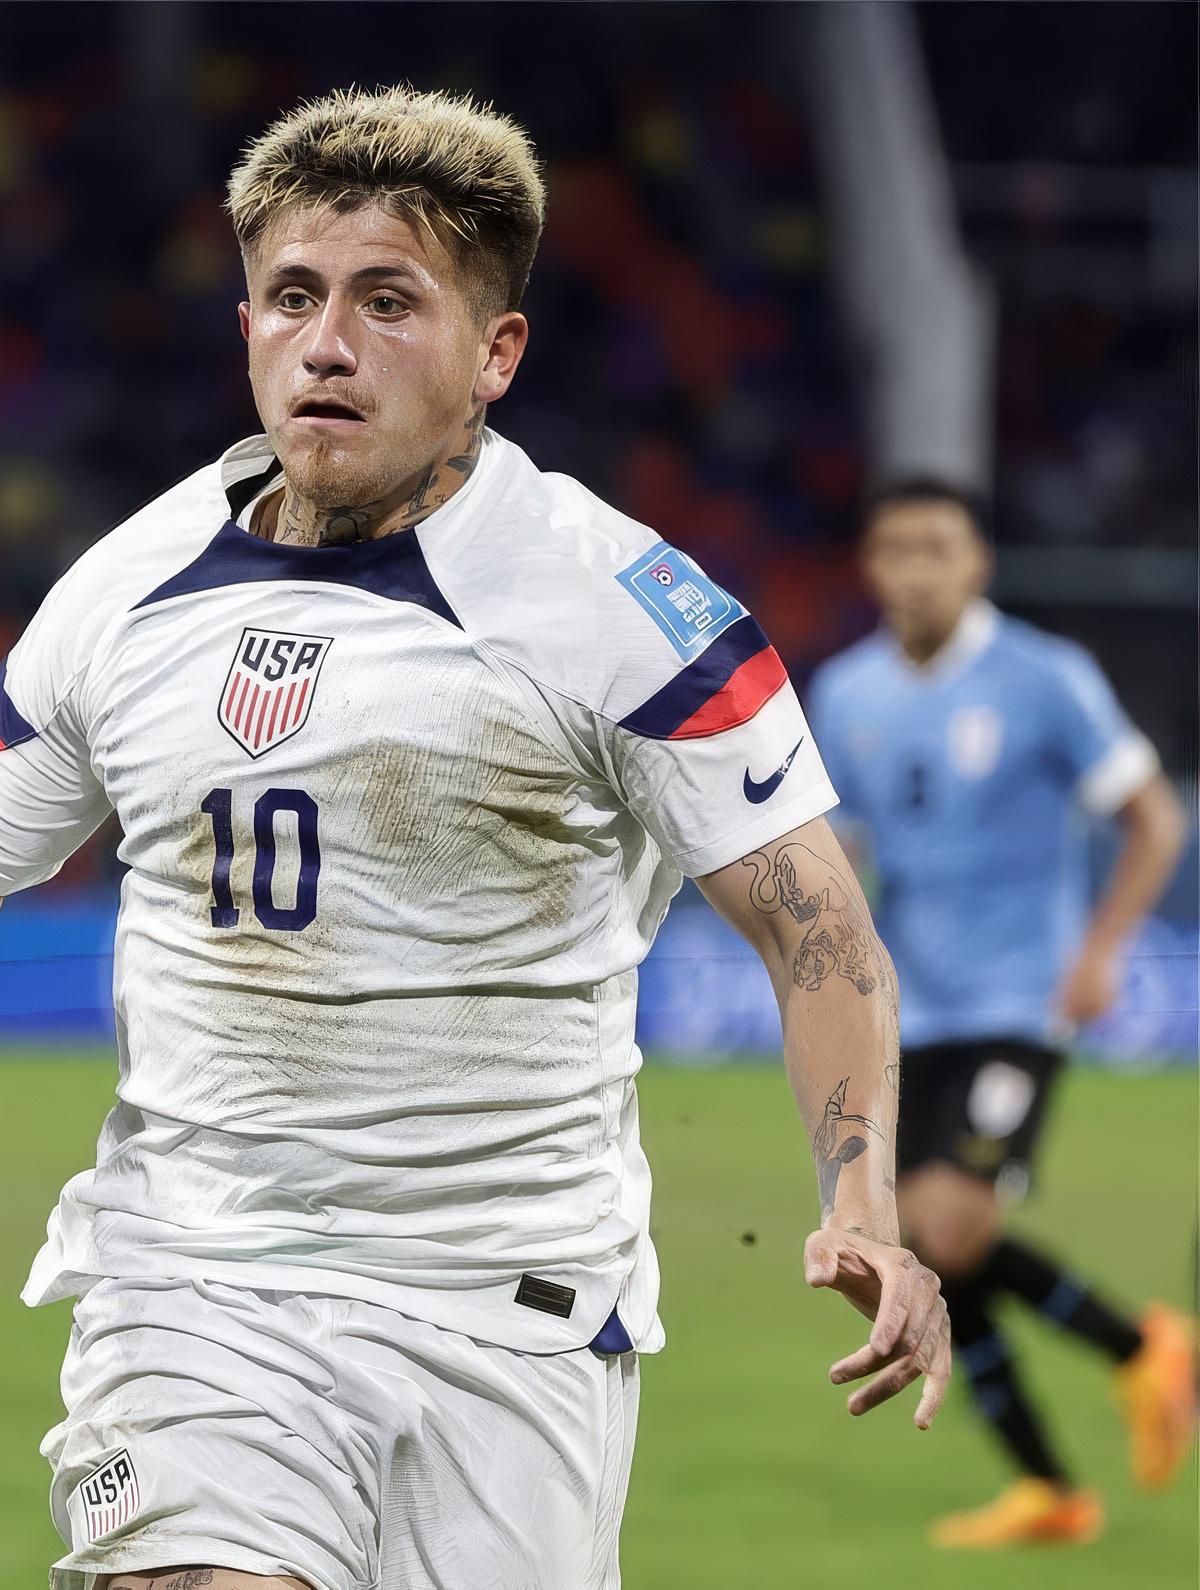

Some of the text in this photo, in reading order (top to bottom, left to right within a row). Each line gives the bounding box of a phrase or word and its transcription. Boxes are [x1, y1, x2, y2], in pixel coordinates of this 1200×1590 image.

[241, 636, 324, 682] USA
[200, 787, 322, 932] 10
[85, 1458, 131, 1506] USA
